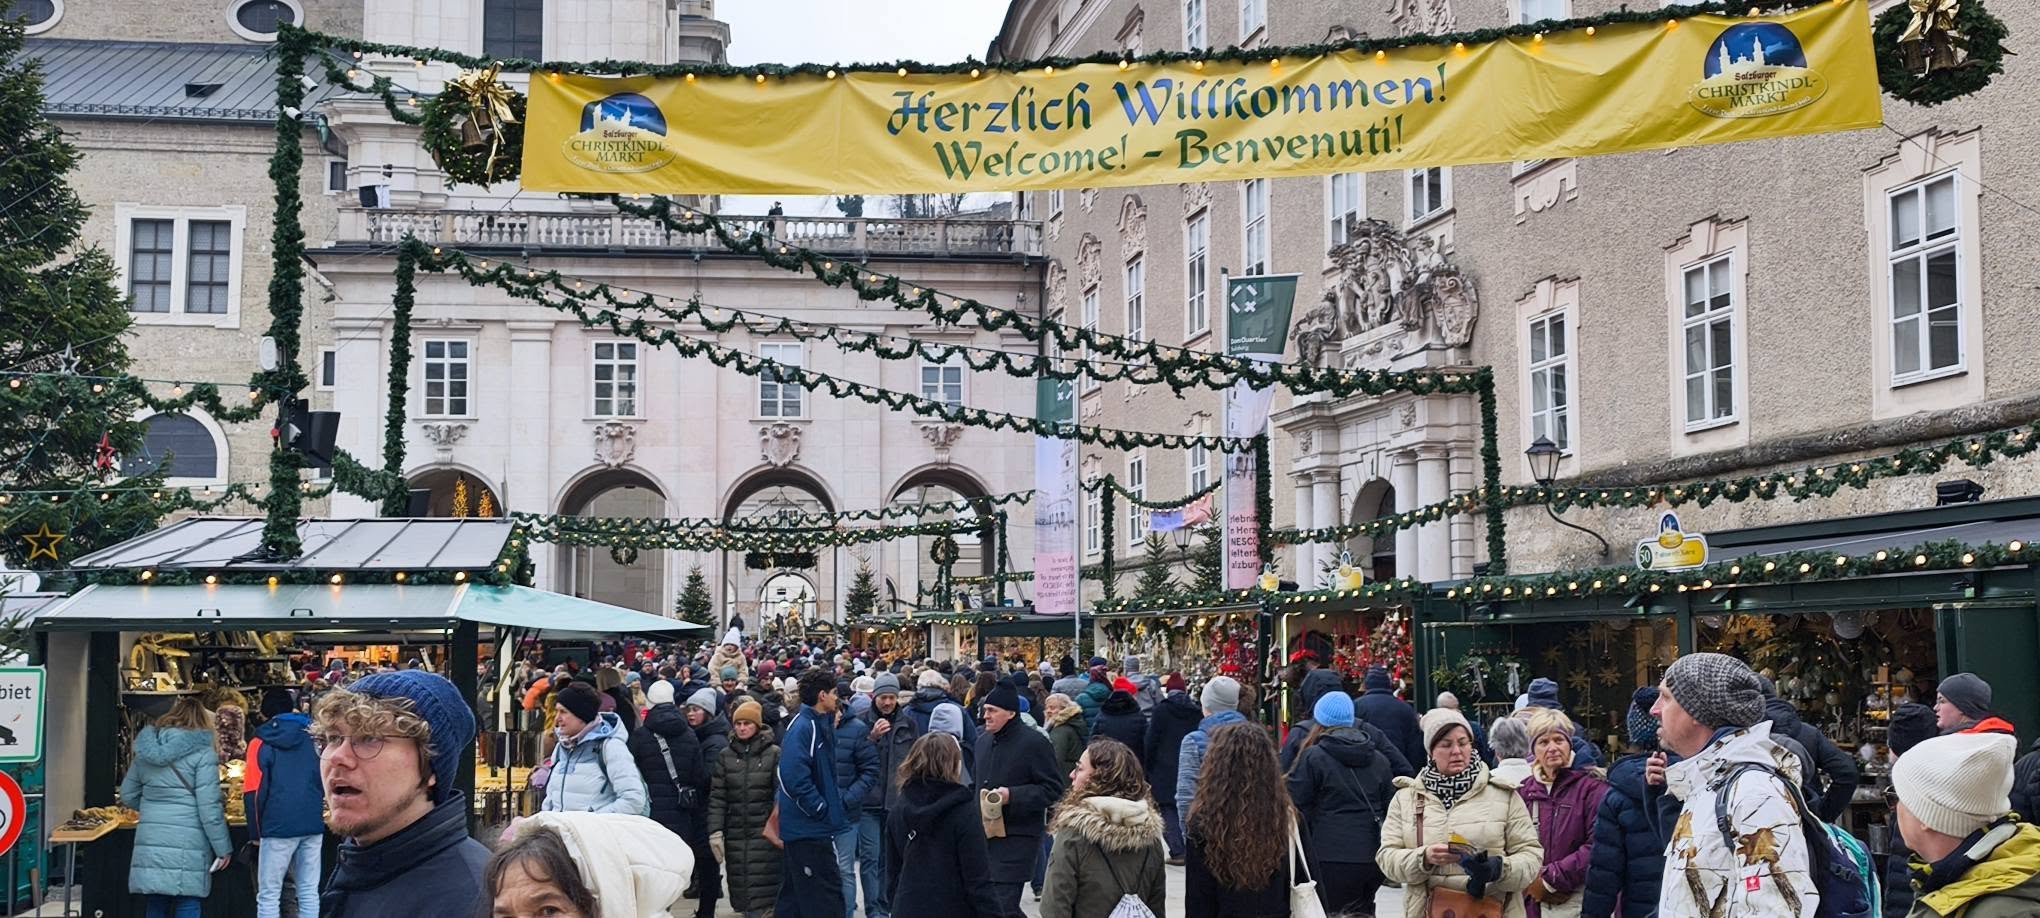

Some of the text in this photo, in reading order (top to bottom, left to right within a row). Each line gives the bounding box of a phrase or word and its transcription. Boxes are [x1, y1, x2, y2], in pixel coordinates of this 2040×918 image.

[1735, 71, 1777, 82] Salzburger
[1698, 76, 1819, 99] CHRISTKINDL-
[887, 62, 1446, 136] Herzlich Willkommen!
[1729, 91, 1789, 109] MARKT
[602, 129, 638, 140] Salzburger
[933, 133, 1128, 181] Welcome!
[1174, 114, 1403, 169] Benvenuti!
[595, 151, 645, 163] MARKT
[0, 683, 31, 699] biet
